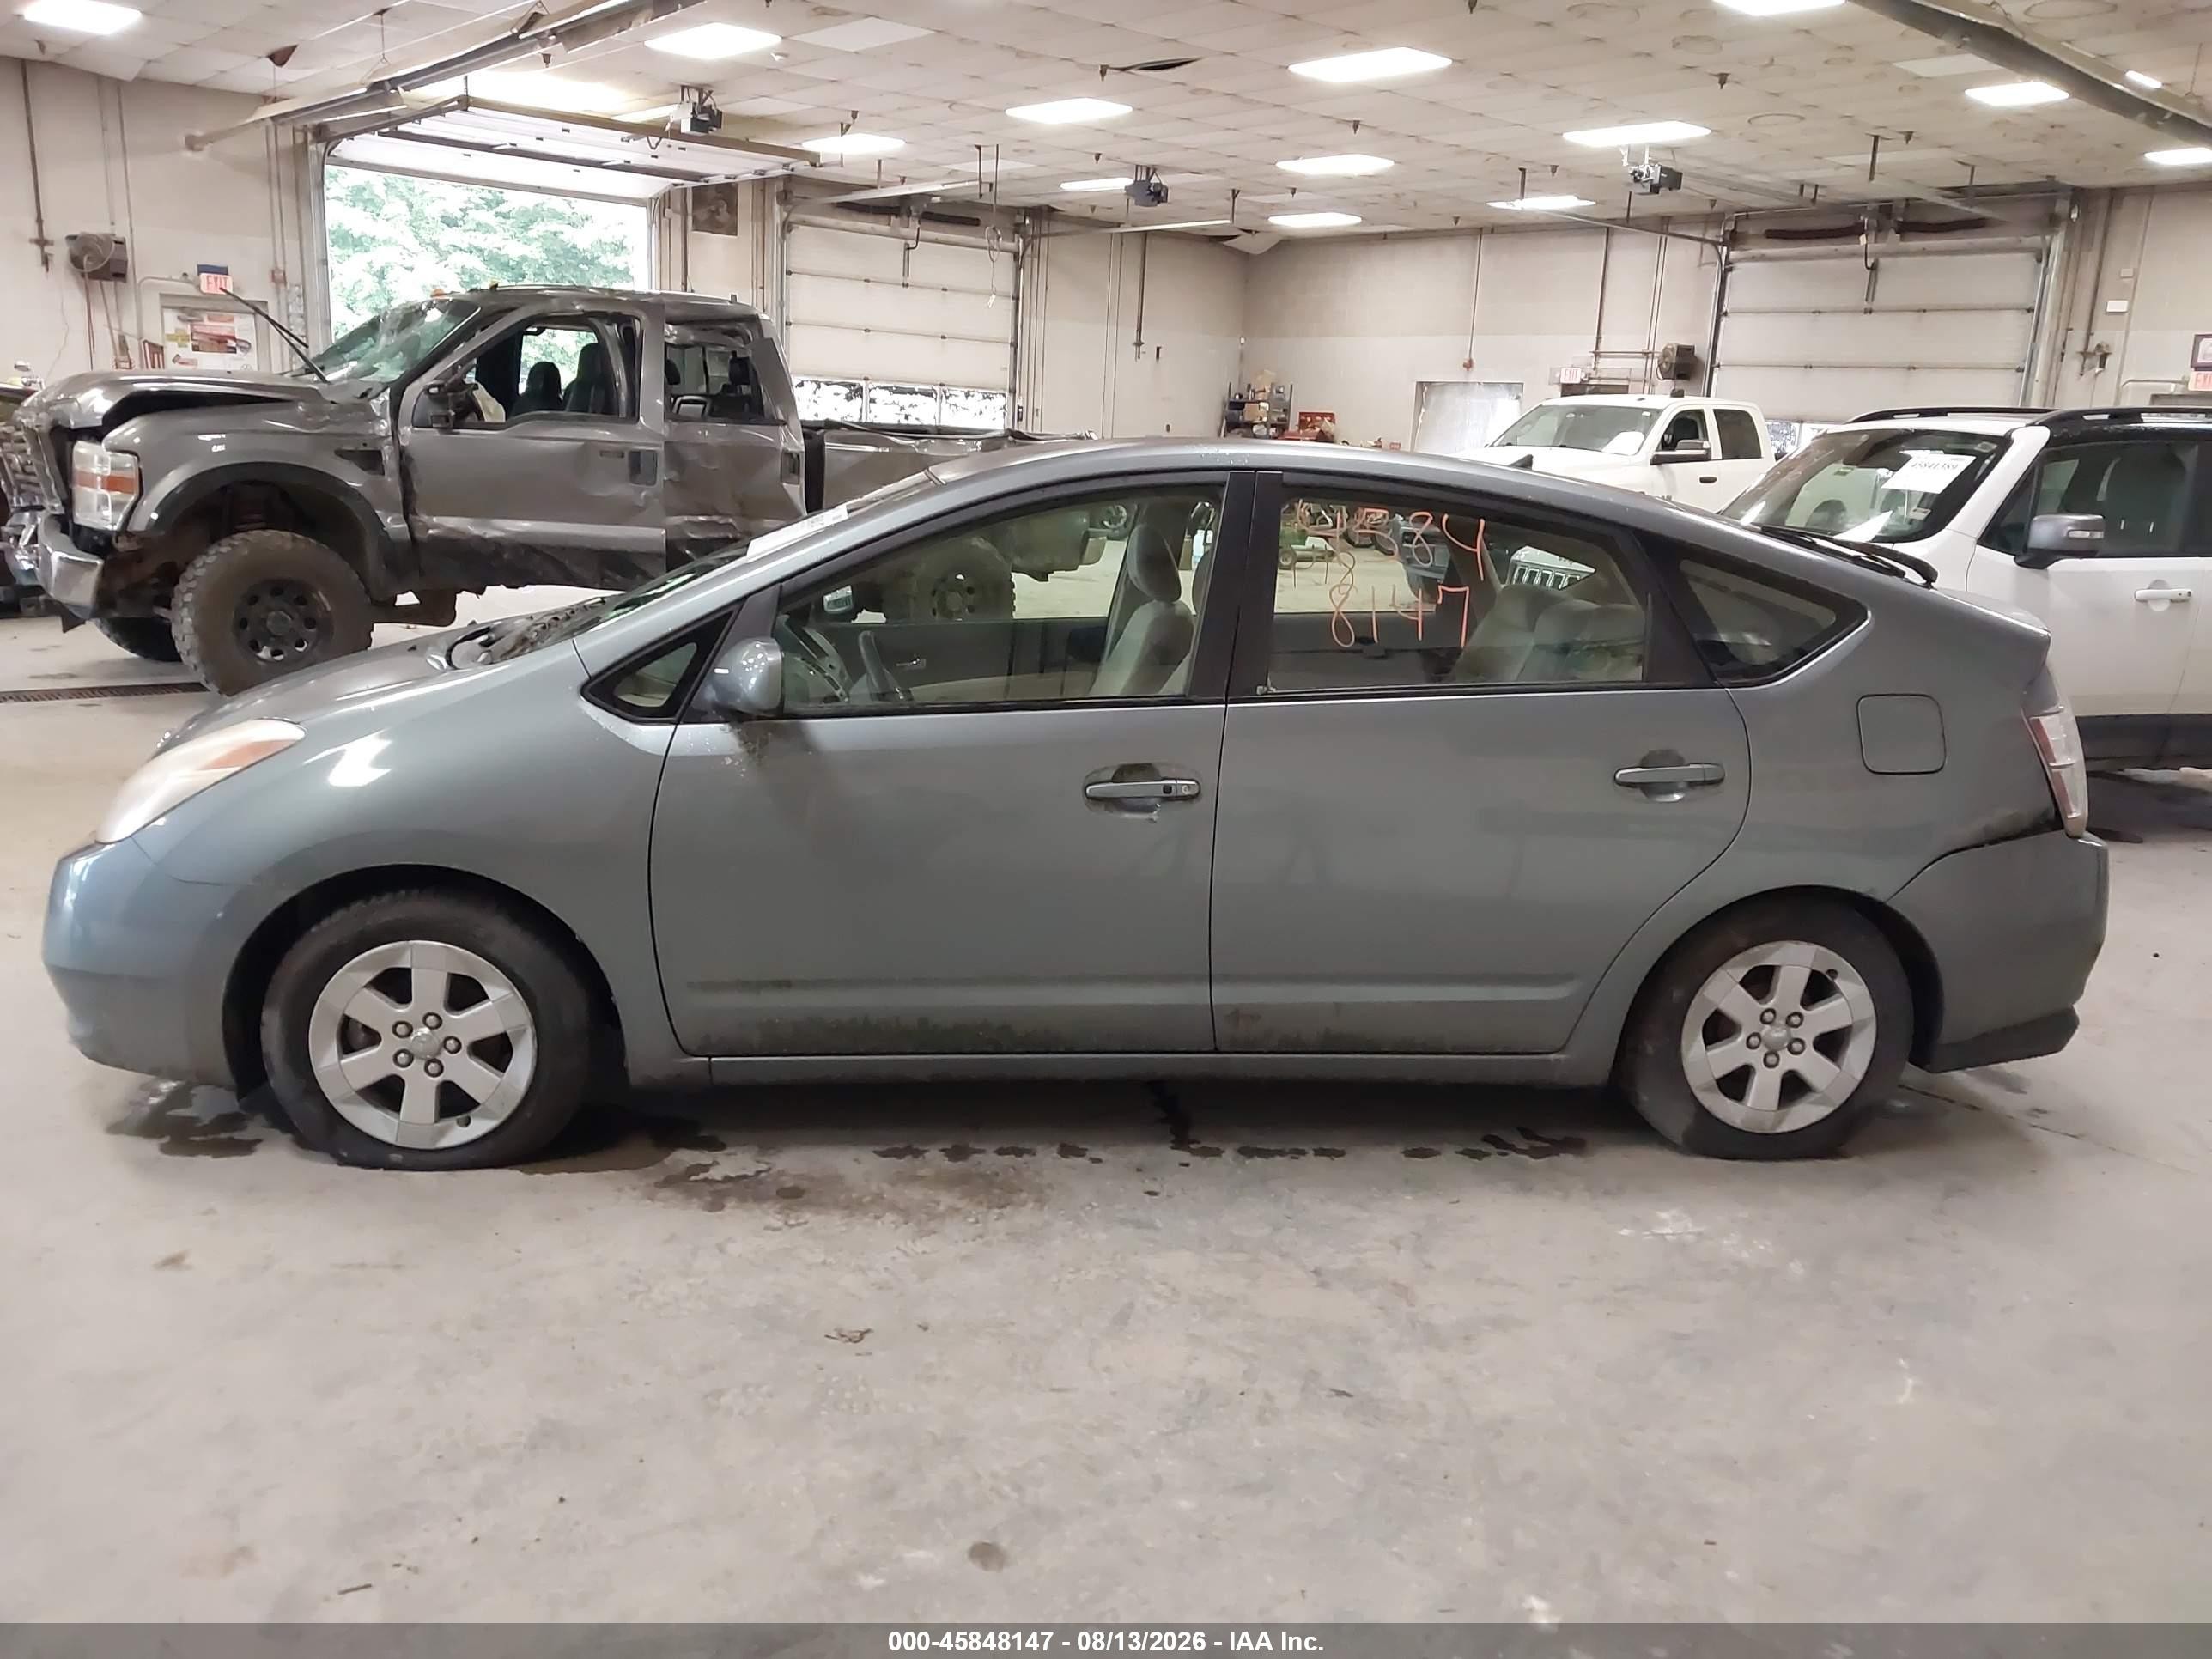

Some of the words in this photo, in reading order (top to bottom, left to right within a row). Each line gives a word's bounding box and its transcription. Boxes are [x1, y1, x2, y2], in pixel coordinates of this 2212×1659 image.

[206, 276, 229, 290] EXIT
[1297, 498, 1486, 581] 4584
[1329, 583, 1470, 648] 8147
